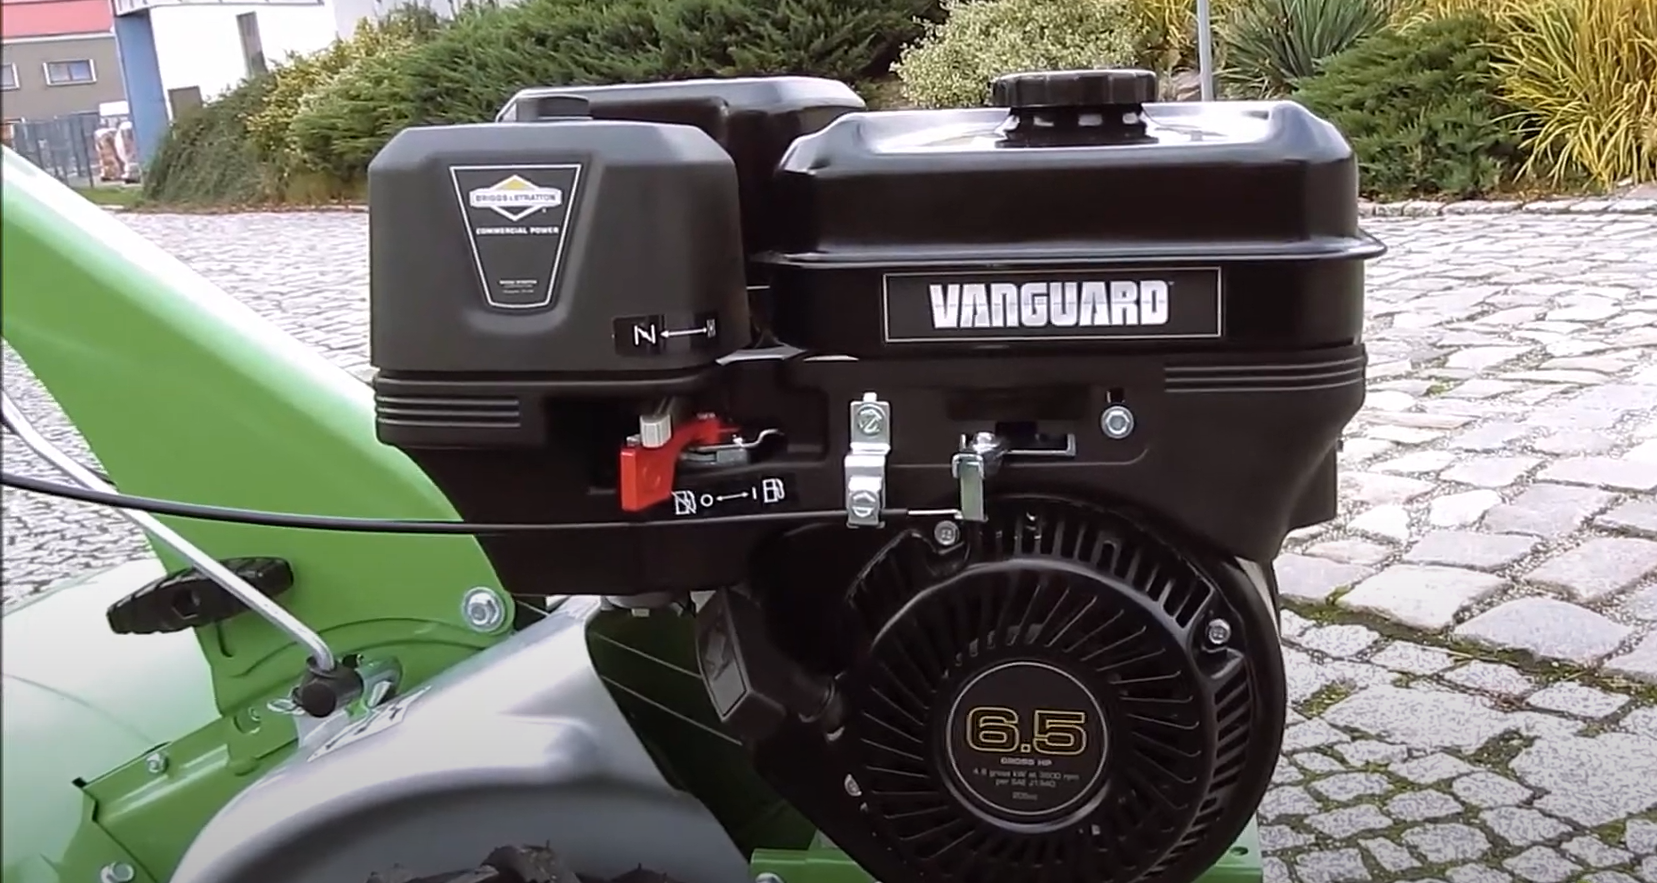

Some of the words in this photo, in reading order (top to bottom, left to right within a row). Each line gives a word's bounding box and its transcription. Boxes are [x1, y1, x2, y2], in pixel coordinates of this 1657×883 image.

[476, 194, 508, 202] BRIGGS
[514, 193, 556, 201] STRATTON
[476, 227, 528, 235] COMMERCIAL
[530, 226, 559, 234] POWER
[929, 280, 1169, 329] VANGUARD
[966, 706, 1087, 756] 6.5
[1000, 757, 1035, 766] GROSS
[1037, 758, 1053, 767] HP
